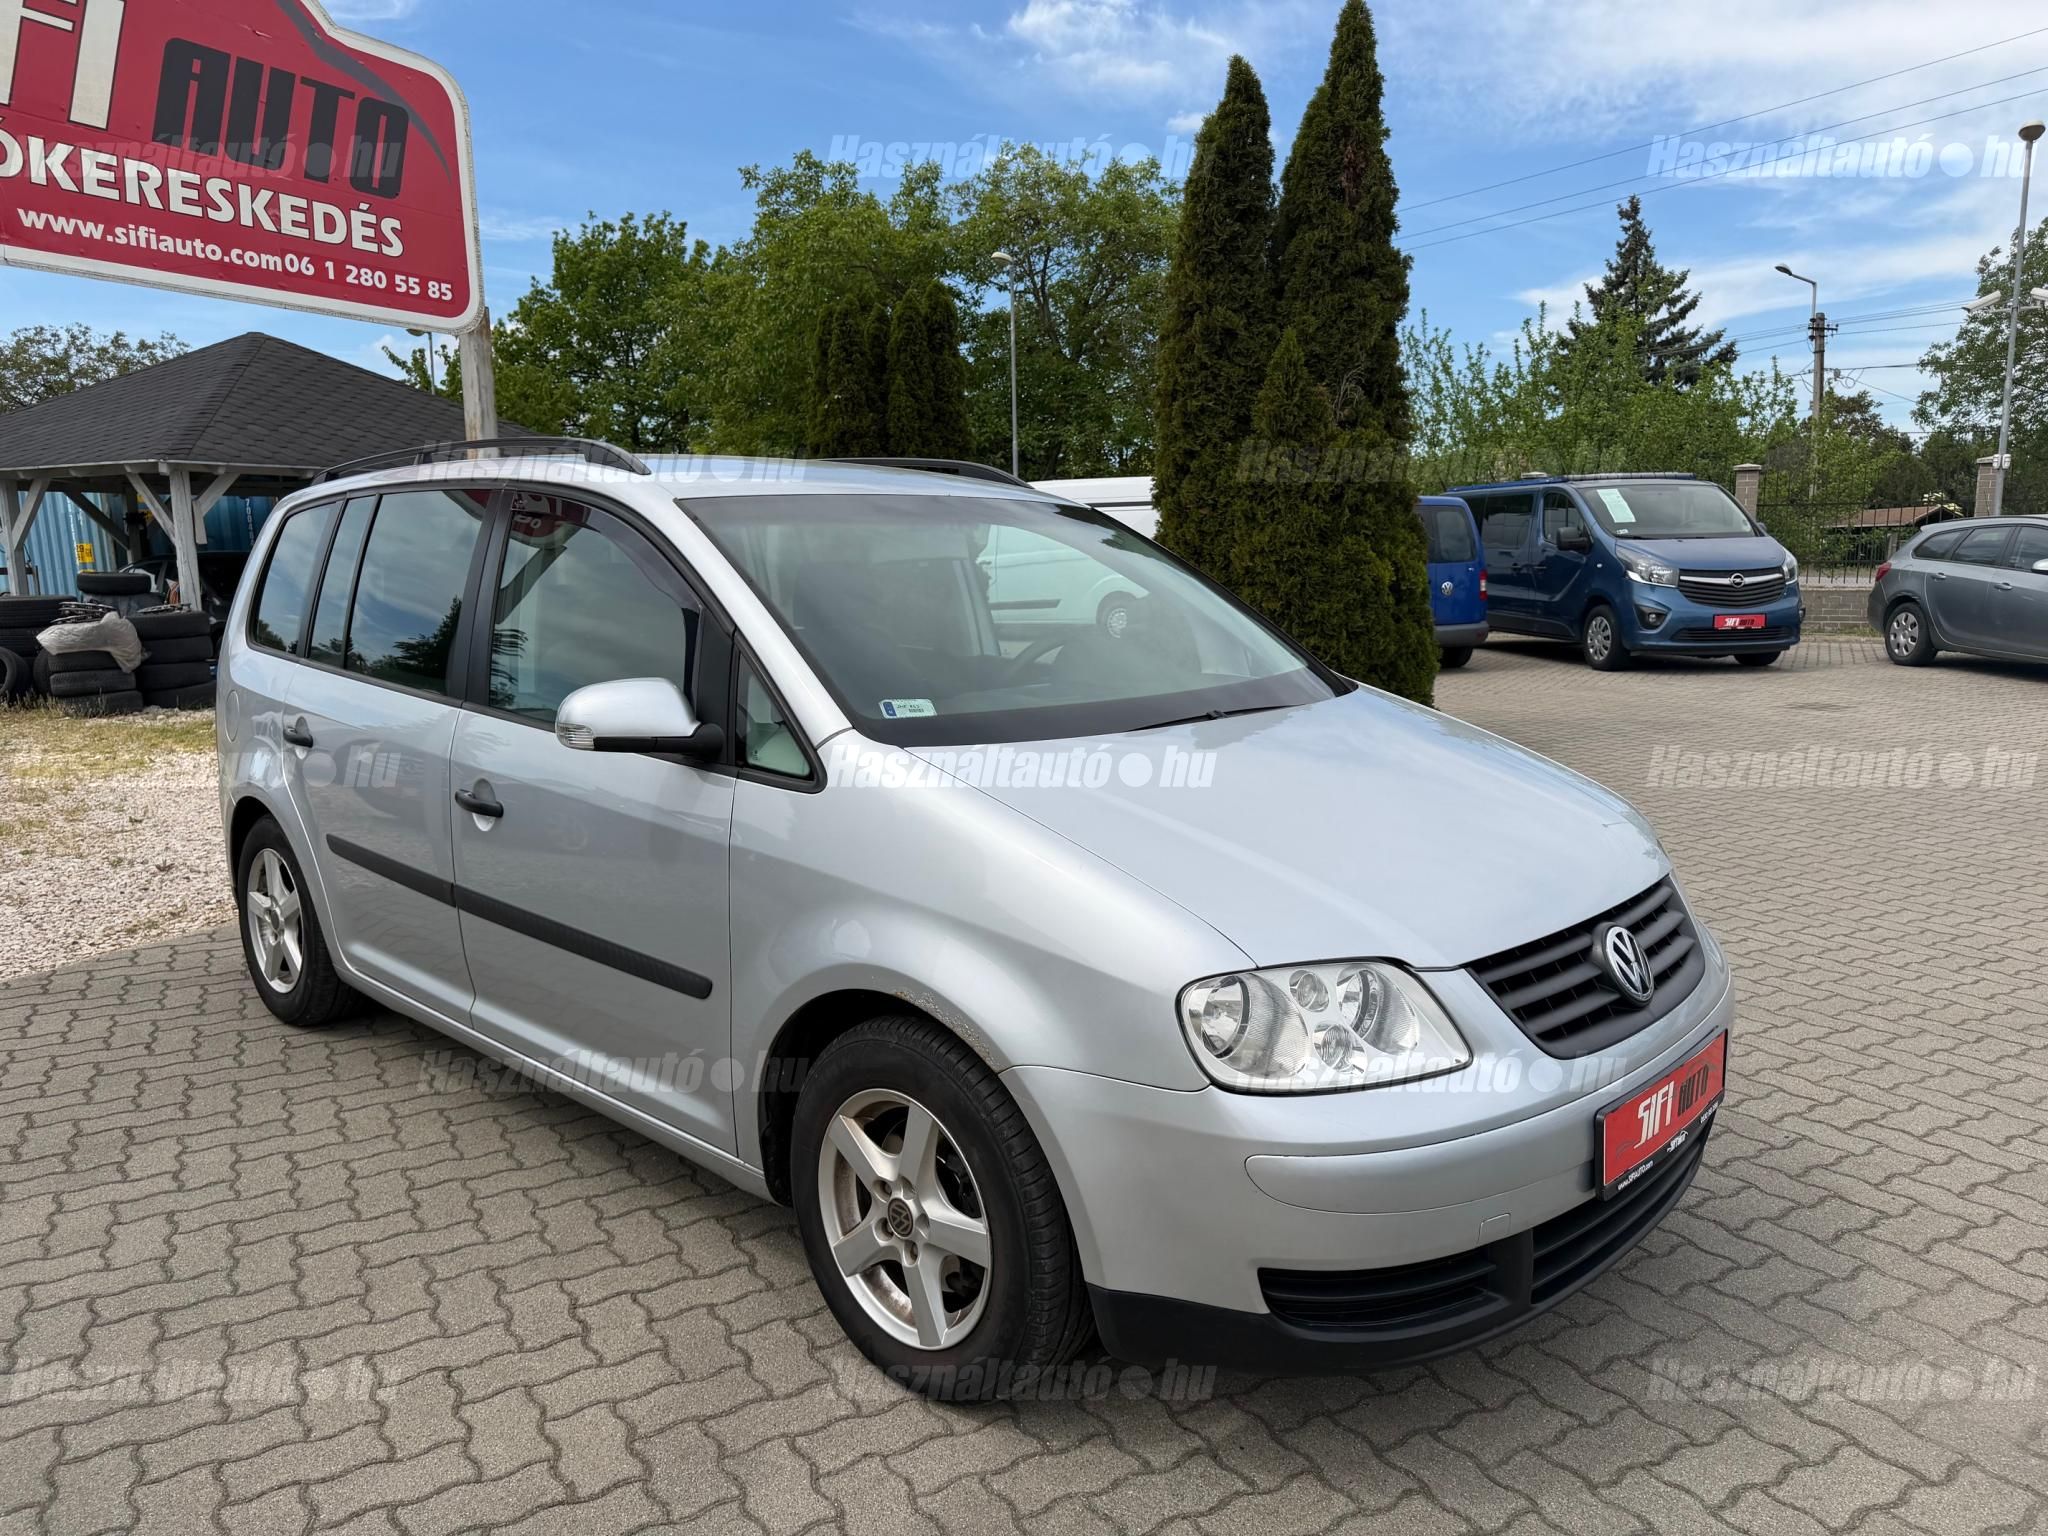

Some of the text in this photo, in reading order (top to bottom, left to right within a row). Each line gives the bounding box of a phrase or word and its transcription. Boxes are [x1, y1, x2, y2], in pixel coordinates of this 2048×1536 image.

[152, 37, 409, 199] AUTO
[17, 208, 453, 301] www.sifiauto.com 06 1 280 55 85
[1633, 1063, 1709, 1149] SIFI AUTO
